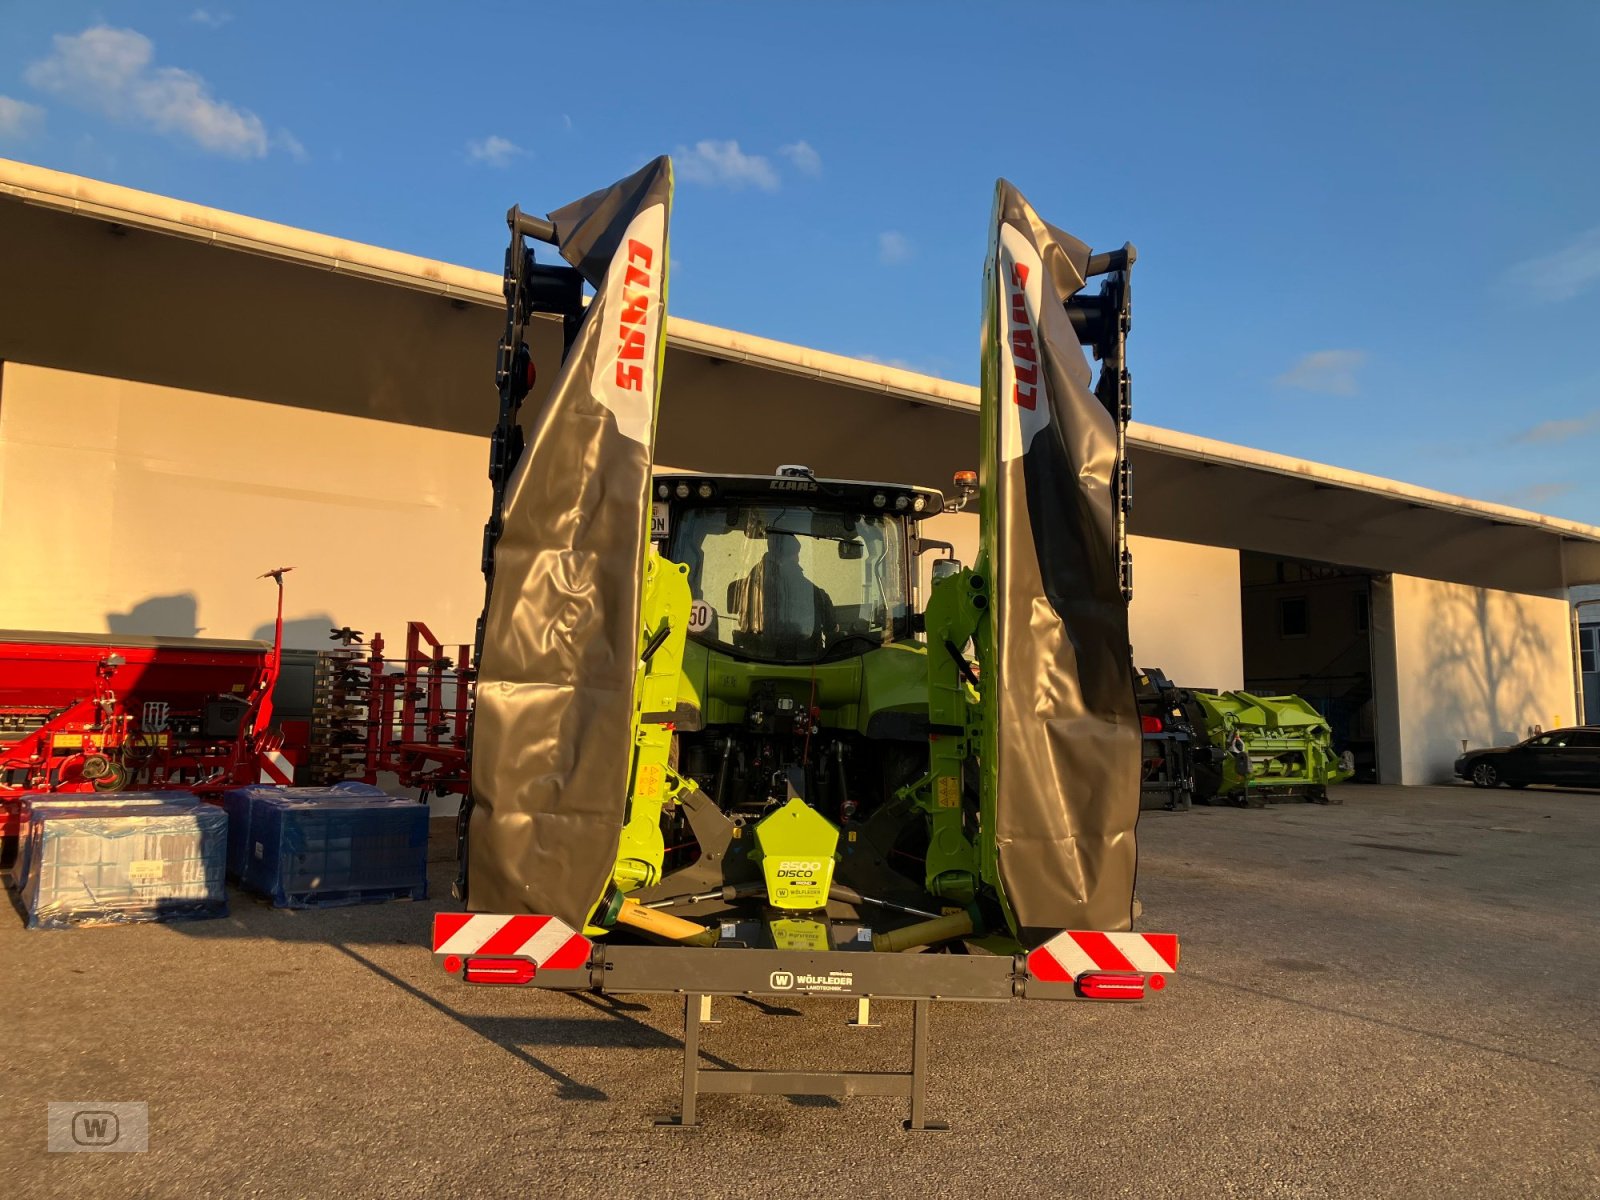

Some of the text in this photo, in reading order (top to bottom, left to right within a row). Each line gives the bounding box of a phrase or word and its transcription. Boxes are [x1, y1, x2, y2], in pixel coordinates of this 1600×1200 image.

[616, 239, 653, 392] CLAAS
[1010, 262, 1037, 411] CLAAS
[770, 480, 818, 492] CLAAS
[689, 606, 707, 626] 50
[777, 870, 813, 878] DISCO
[775, 975, 789, 986] W
[796, 974, 853, 986] WÖLFLEDER
